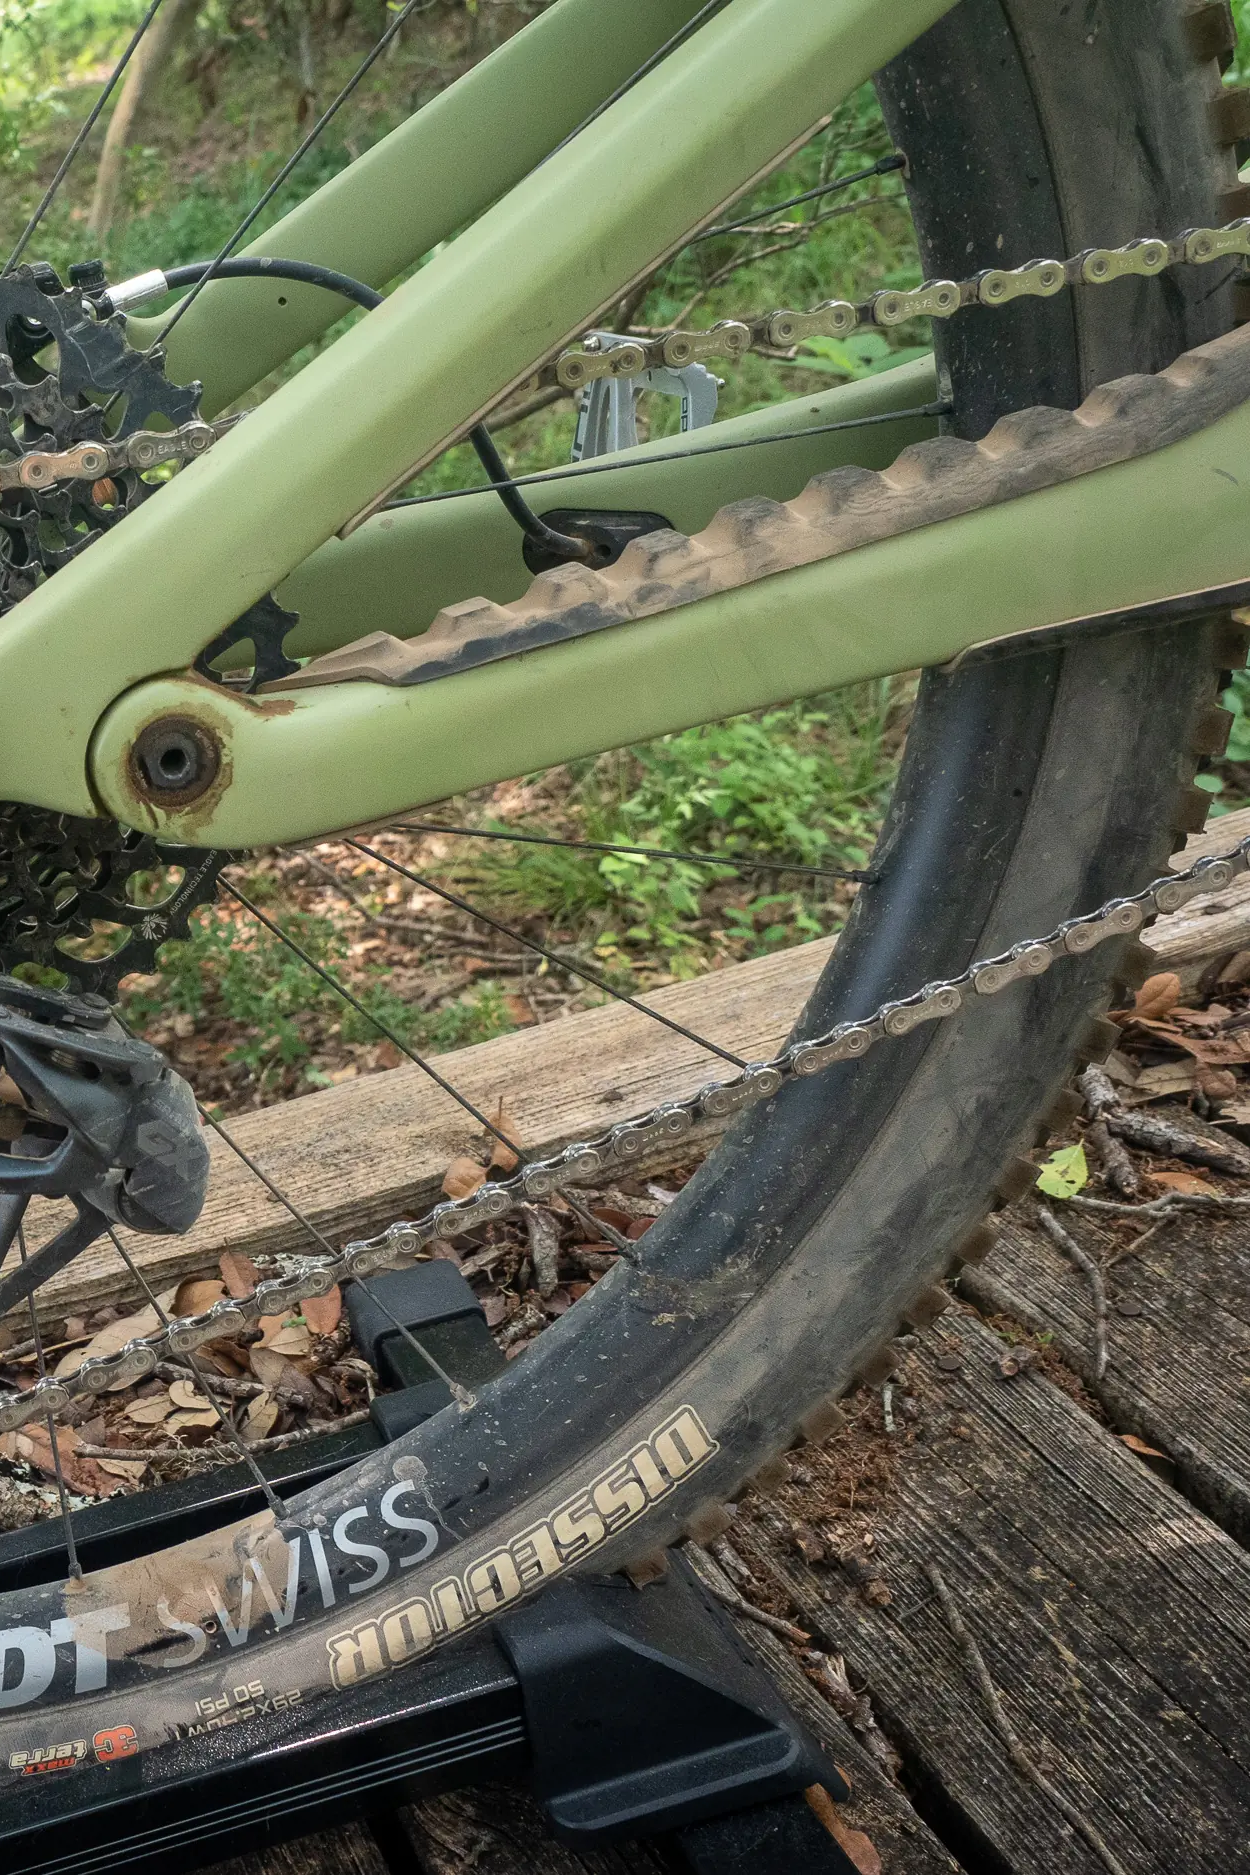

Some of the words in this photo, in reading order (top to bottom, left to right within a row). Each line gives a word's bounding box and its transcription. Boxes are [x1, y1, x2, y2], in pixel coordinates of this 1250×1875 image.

[158, 440, 188, 455] EAGLE
[200, 849, 218, 873] EAGLE
[170, 873, 204, 916] TECHNOLOGY
[326, 1404, 720, 1691] DISSECTOR
[157, 1479, 439, 1668] SWISS
[194, 1692, 230, 1717] PSI
[233, 1679, 265, 1703] 50
[9, 1739, 87, 1770] terra
[93, 1724, 140, 1764] 3C
[22, 1757, 76, 1775] maxx
